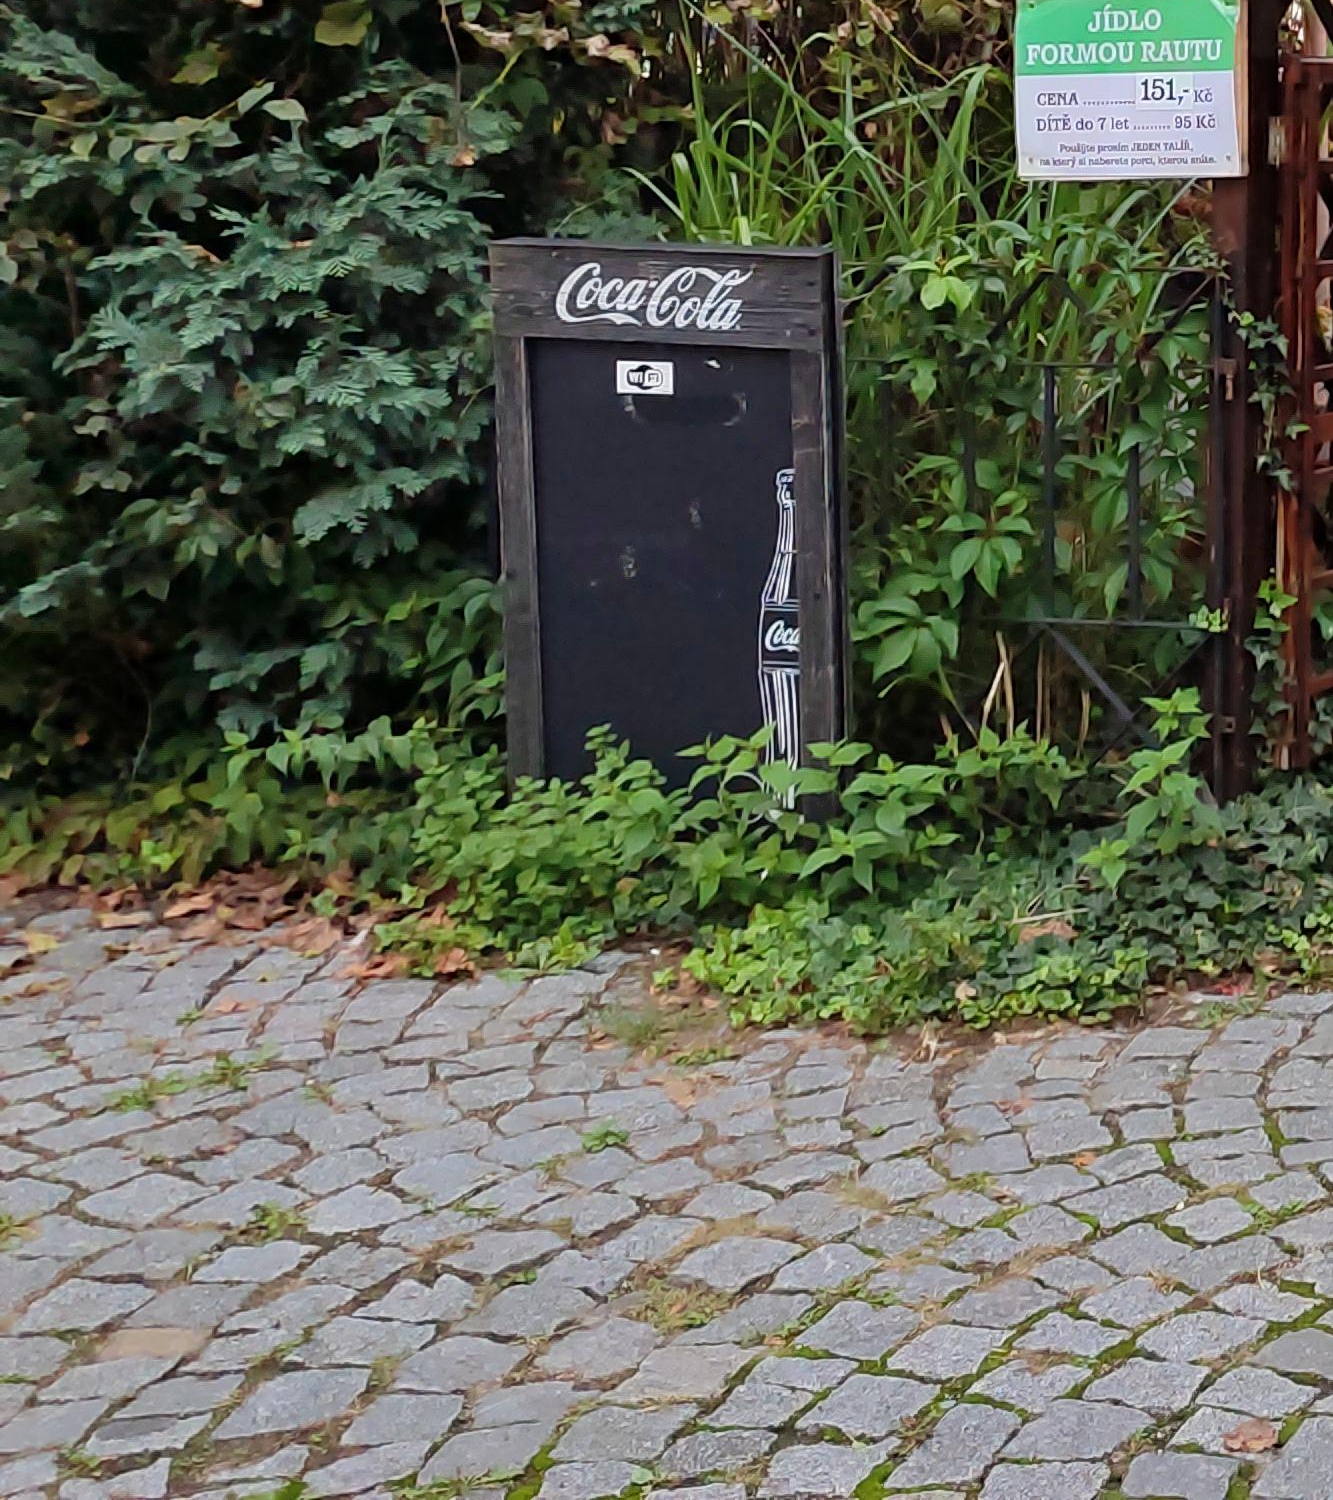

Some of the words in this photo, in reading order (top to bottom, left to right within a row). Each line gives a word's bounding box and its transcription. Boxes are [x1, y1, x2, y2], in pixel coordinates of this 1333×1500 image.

[1087, 4, 1162, 33] JÍDLO
[1026, 42, 1134, 66] FORMOU
[1141, 39, 1222, 62] RAUTU
[1037, 92, 1078, 106] CENA
[1193, 87, 1213, 103] Kč
[1036, 114, 1071, 132] DÍTĚ
[1076, 116, 1093, 131] do
[1097, 117, 1106, 131] 7
[1110, 117, 1130, 131] let
[1175, 116, 1191, 129] 95
[1196, 114, 1215, 129] Kč
[1131, 142, 1161, 152] JEDEN
[556, 263, 754, 331] Coca-Cola
